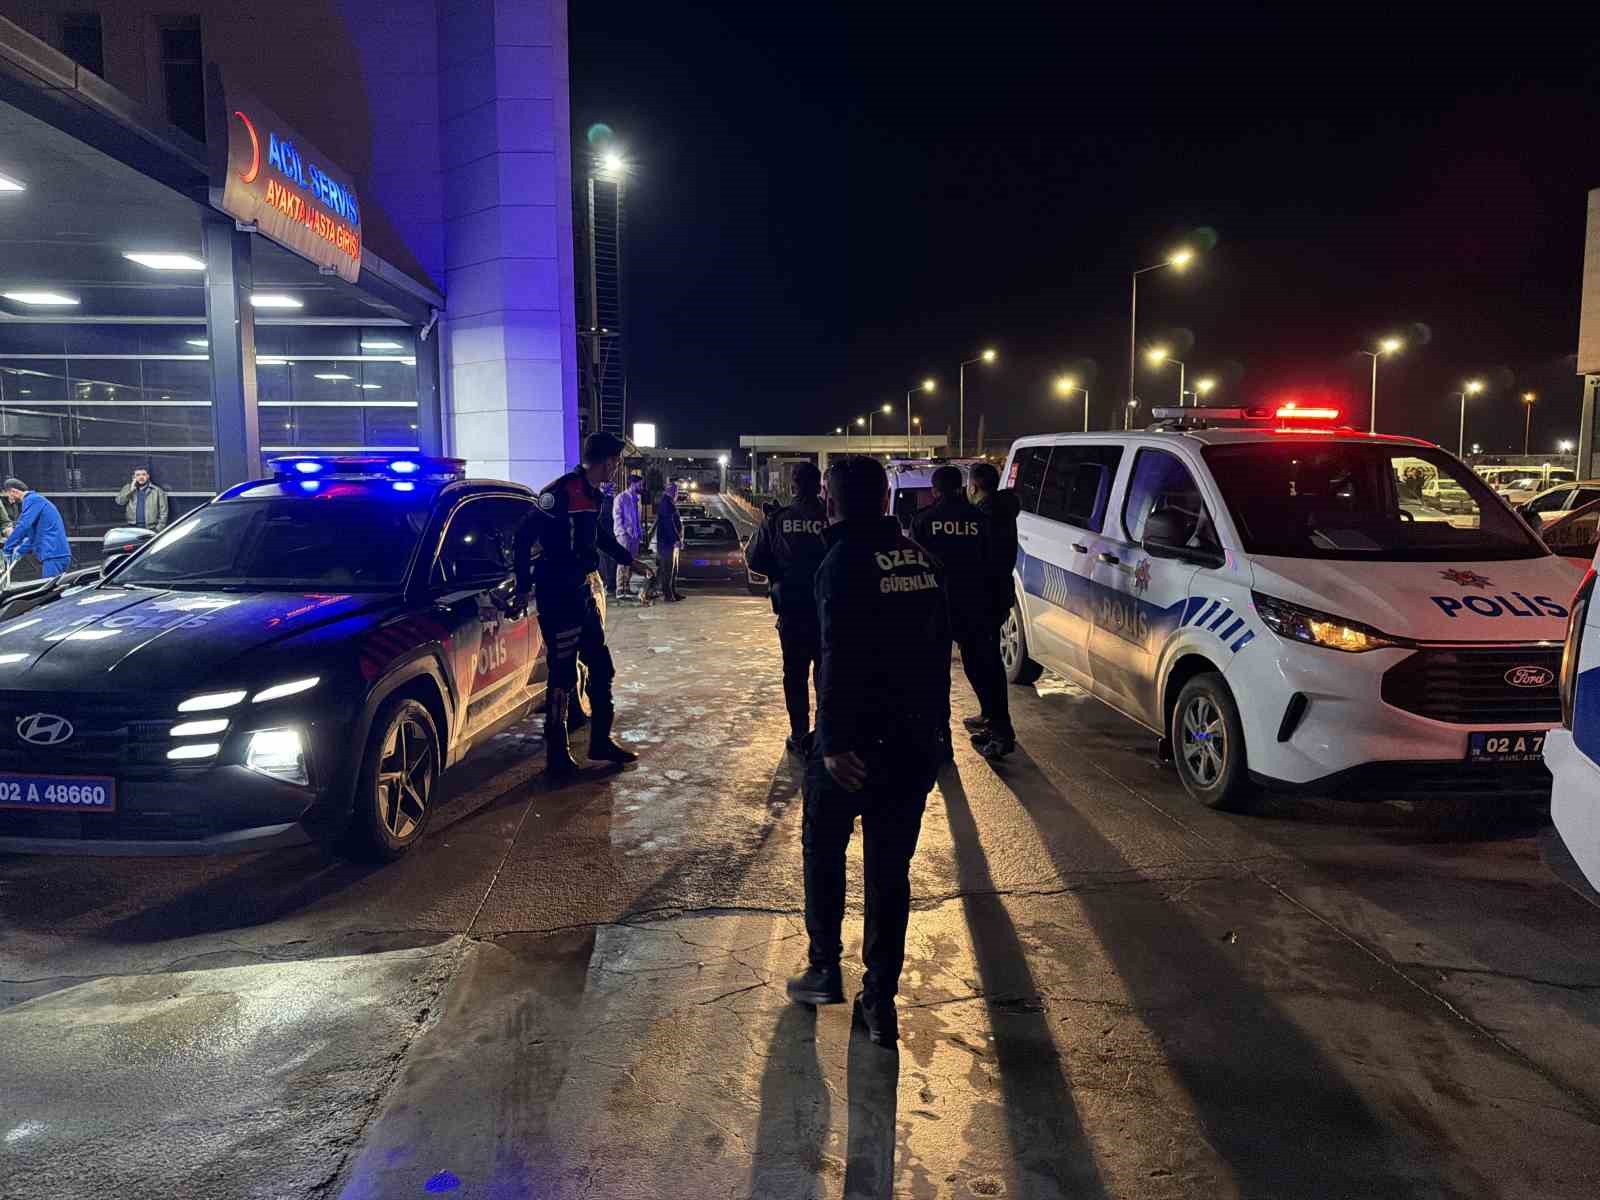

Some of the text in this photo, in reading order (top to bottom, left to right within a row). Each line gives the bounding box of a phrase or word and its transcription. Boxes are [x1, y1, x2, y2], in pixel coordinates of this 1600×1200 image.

[265, 180, 305, 224] AYAKTA
[309, 164, 359, 225] SERVİS
[931, 520, 979, 536] POLİS
[874, 549, 930, 571] ÖZEL
[1430, 591, 1569, 618] POLİS
[1513, 669, 1546, 685] Ford
[1486, 737, 1510, 753] 02
[1514, 736, 1527, 752] A
[0, 782, 105, 805] 02 A 48660
